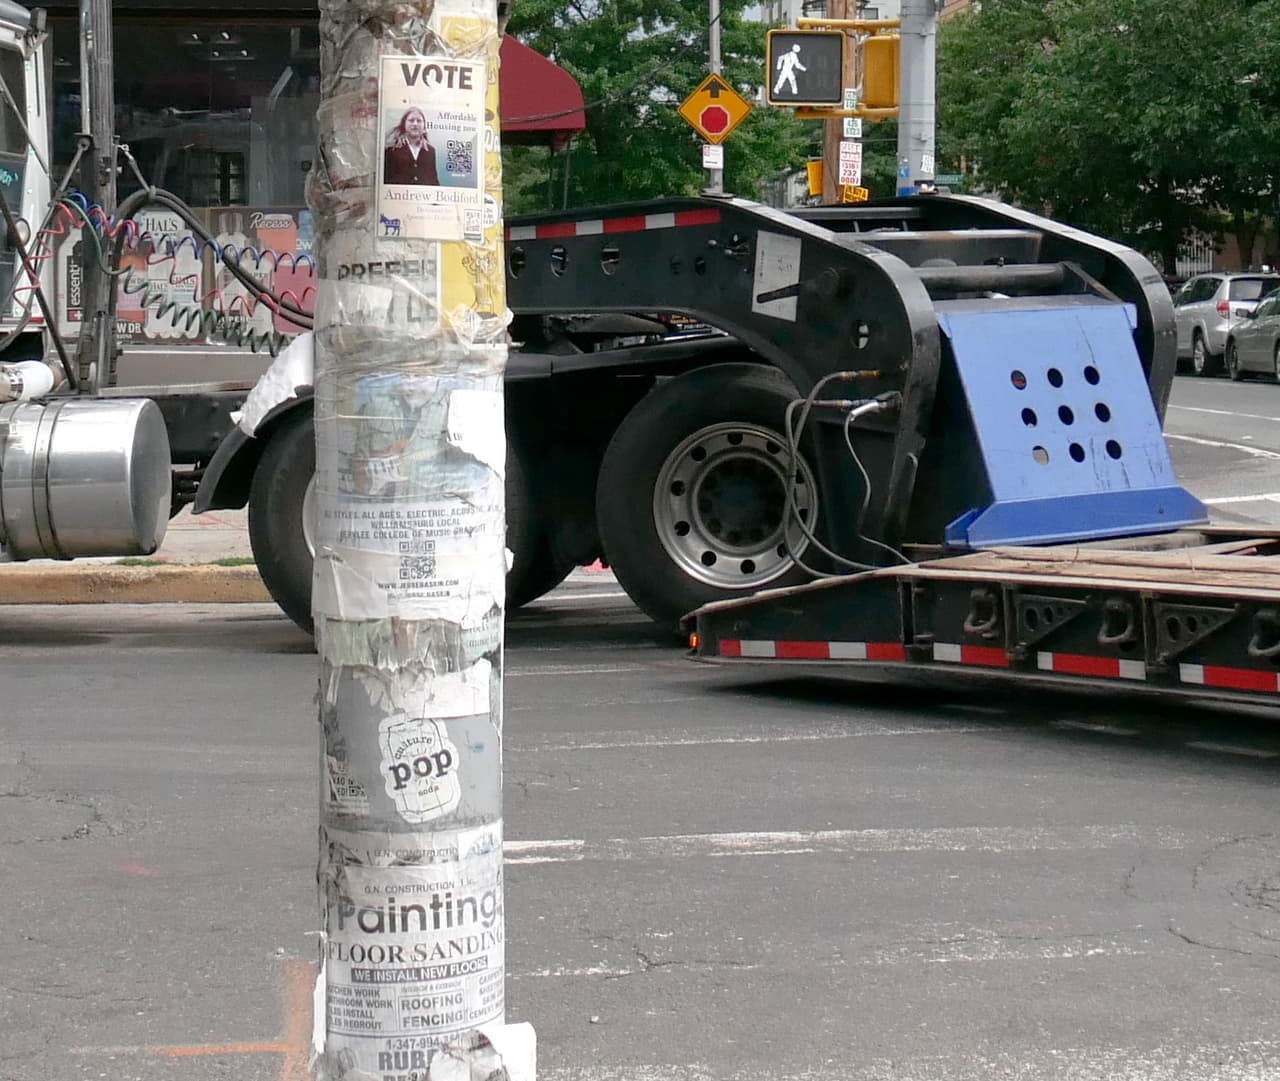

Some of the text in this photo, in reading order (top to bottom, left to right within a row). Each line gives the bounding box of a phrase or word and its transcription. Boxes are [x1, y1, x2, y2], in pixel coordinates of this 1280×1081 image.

[400, 63, 473, 91] VOTE
[437, 111, 477, 122] Affordable
[426, 121, 462, 132] Housing
[384, 189, 479, 204] Andrew Bodiford
[145, 217, 179, 232] HAL'S
[249, 212, 291, 229] Recess
[436, 519, 461, 527] LOCAL
[373, 530, 409, 540] COLLEGE
[412, 530, 424, 538] OF
[426, 528, 449, 538] MUSIC
[394, 735, 432, 760] culture
[388, 749, 452, 790] pop
[418, 785, 440, 797] soda
[385, 881, 455, 893] CONSTRUCTION
[337, 891, 497, 935] Painting
[329, 927, 503, 964] FLOOR SANDING
[354, 970, 371, 982] WE
[373, 968, 419, 982] INSTALL
[420, 966, 448, 980] NEW
[354, 988, 380, 998] WORK
[366, 999, 393, 1009] WORK
[401, 993, 463, 1011] ROOFING
[343, 1009, 375, 1019] INSTALL
[402, 1011, 463, 1028] FENCING
[343, 1021, 382, 1031] REGROUT
